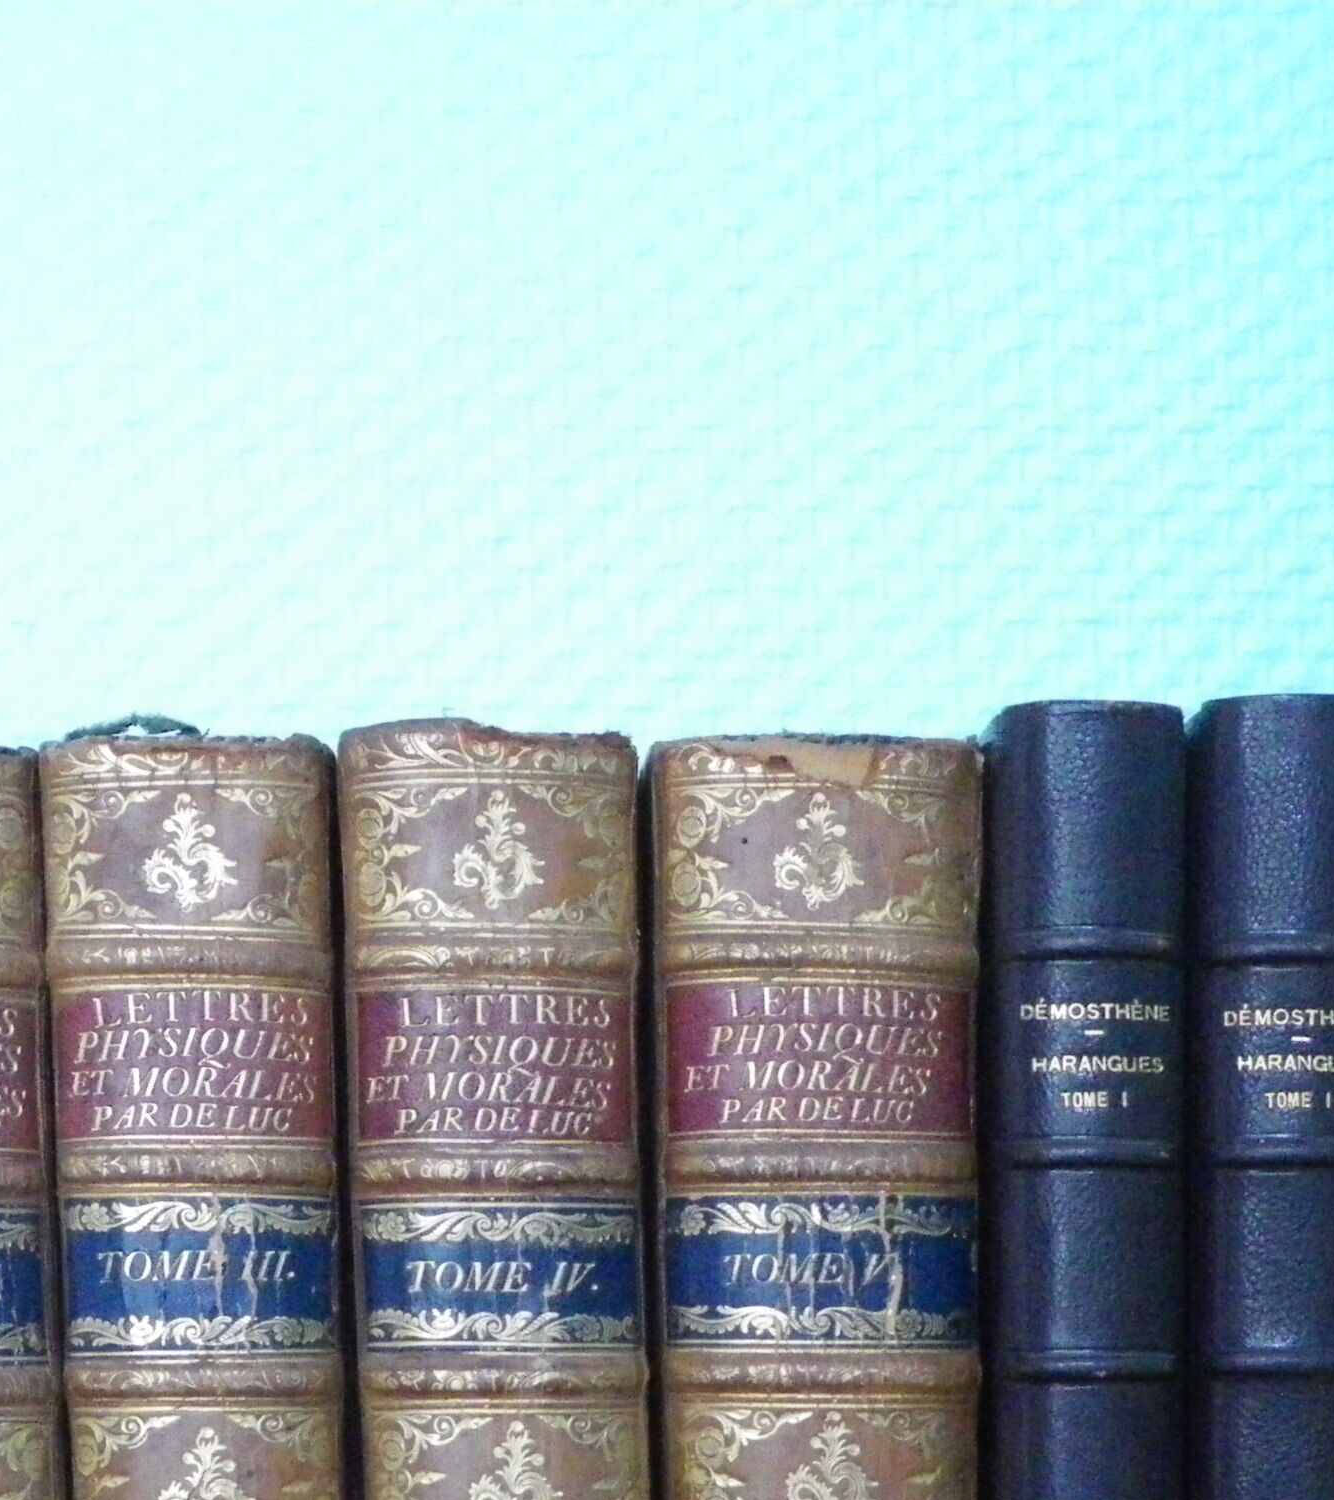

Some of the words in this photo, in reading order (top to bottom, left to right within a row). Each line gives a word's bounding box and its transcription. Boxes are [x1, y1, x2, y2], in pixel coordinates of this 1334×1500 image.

[92, 991, 310, 1029] LETTRES
[399, 994, 610, 1028] LETTRES
[725, 986, 942, 1022] LETTRES
[1020, 999, 1171, 1022] DÉMOSTHÈNE
[77, 1027, 314, 1068] PHYSIQUES
[382, 1034, 617, 1077] PHYSIQUES
[707, 1022, 944, 1062] PHYSIQUES
[684, 1063, 724, 1094] ET
[739, 1060, 933, 1097] MORALES
[1032, 1055, 1165, 1074] HARANGUES
[69, 1068, 114, 1098] ET
[121, 1067, 318, 1104] MORALES
[366, 1075, 409, 1103] ET
[419, 1071, 612, 1110] MORALES
[1061, 1092, 1109, 1109] TOME
[1120, 1091, 1128, 1109] I
[1264, 1092, 1313, 1109] TOME
[92, 1104, 160, 1131] PAR
[168, 1103, 216, 1129] DE
[224, 1106, 293, 1131] LUC
[394, 1107, 464, 1135] PAR
[473, 1107, 522, 1132] DE
[527, 1108, 594, 1135] LUC
[719, 1097, 787, 1123] PAR
[798, 1096, 847, 1122] DE
[850, 1098, 916, 1124] LUC
[98, 1250, 219, 1284] TOME
[406, 1260, 532, 1293] TOME
[723, 1252, 847, 1285] TOME
